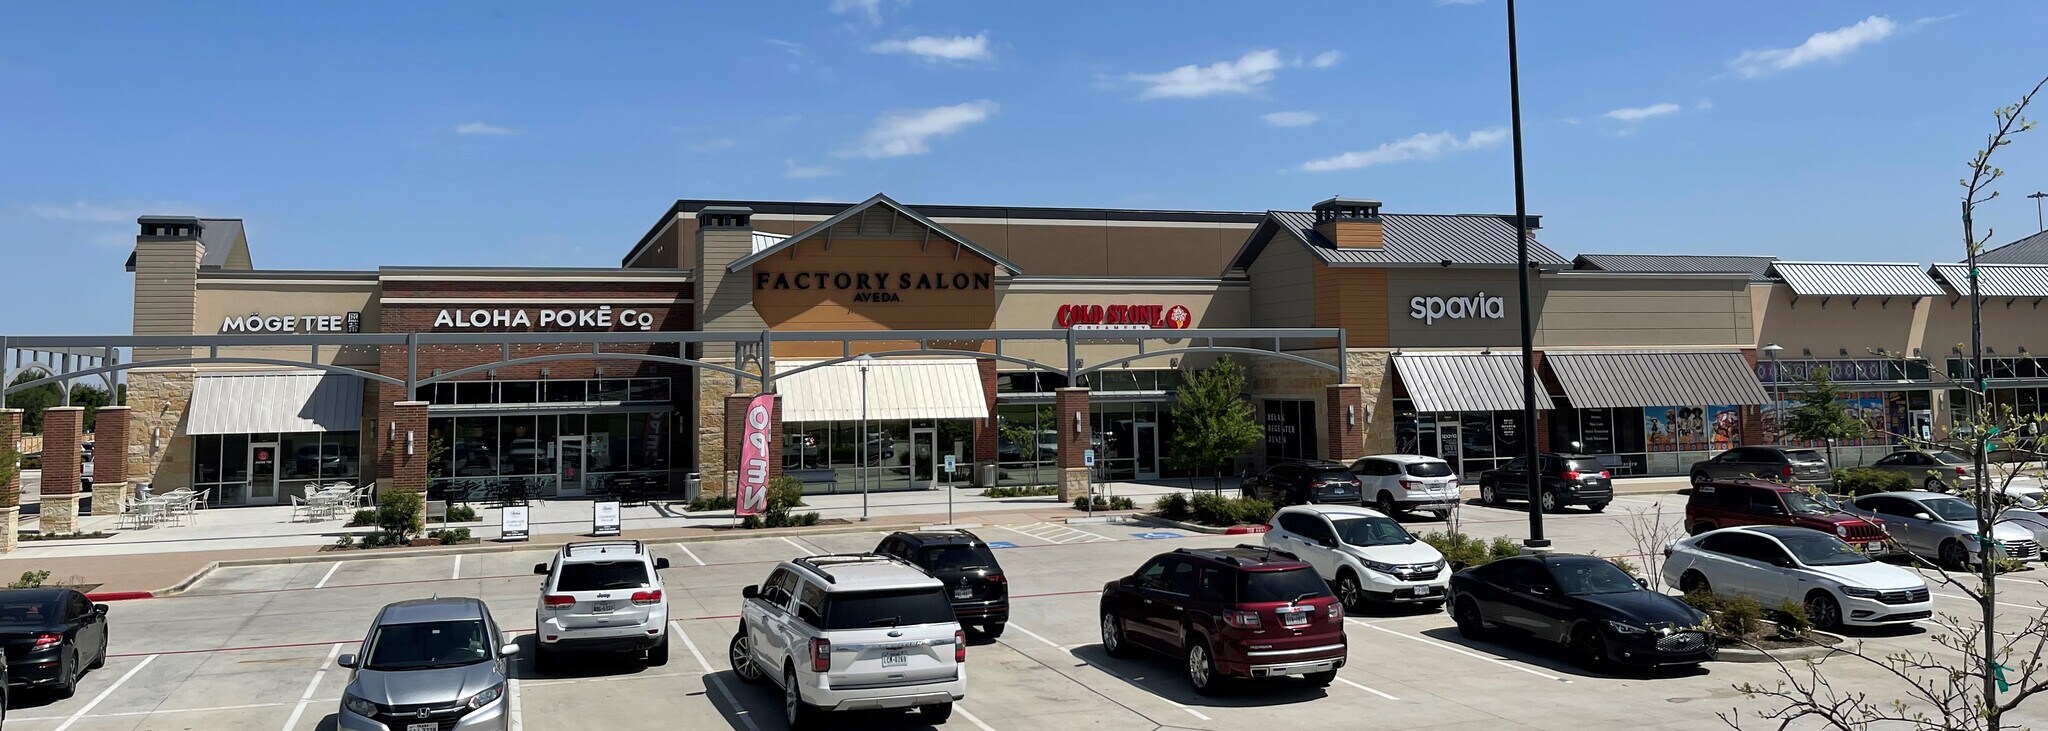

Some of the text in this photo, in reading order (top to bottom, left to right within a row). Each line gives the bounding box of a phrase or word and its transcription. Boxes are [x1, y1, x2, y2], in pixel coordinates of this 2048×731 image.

[756, 272, 991, 290] FACTORY SALON
[434, 309, 532, 327] ALOHA
[1057, 304, 1164, 327] COLD STONE
[1410, 291, 1505, 325] spavia
[222, 312, 342, 332] MÖGE TEE
